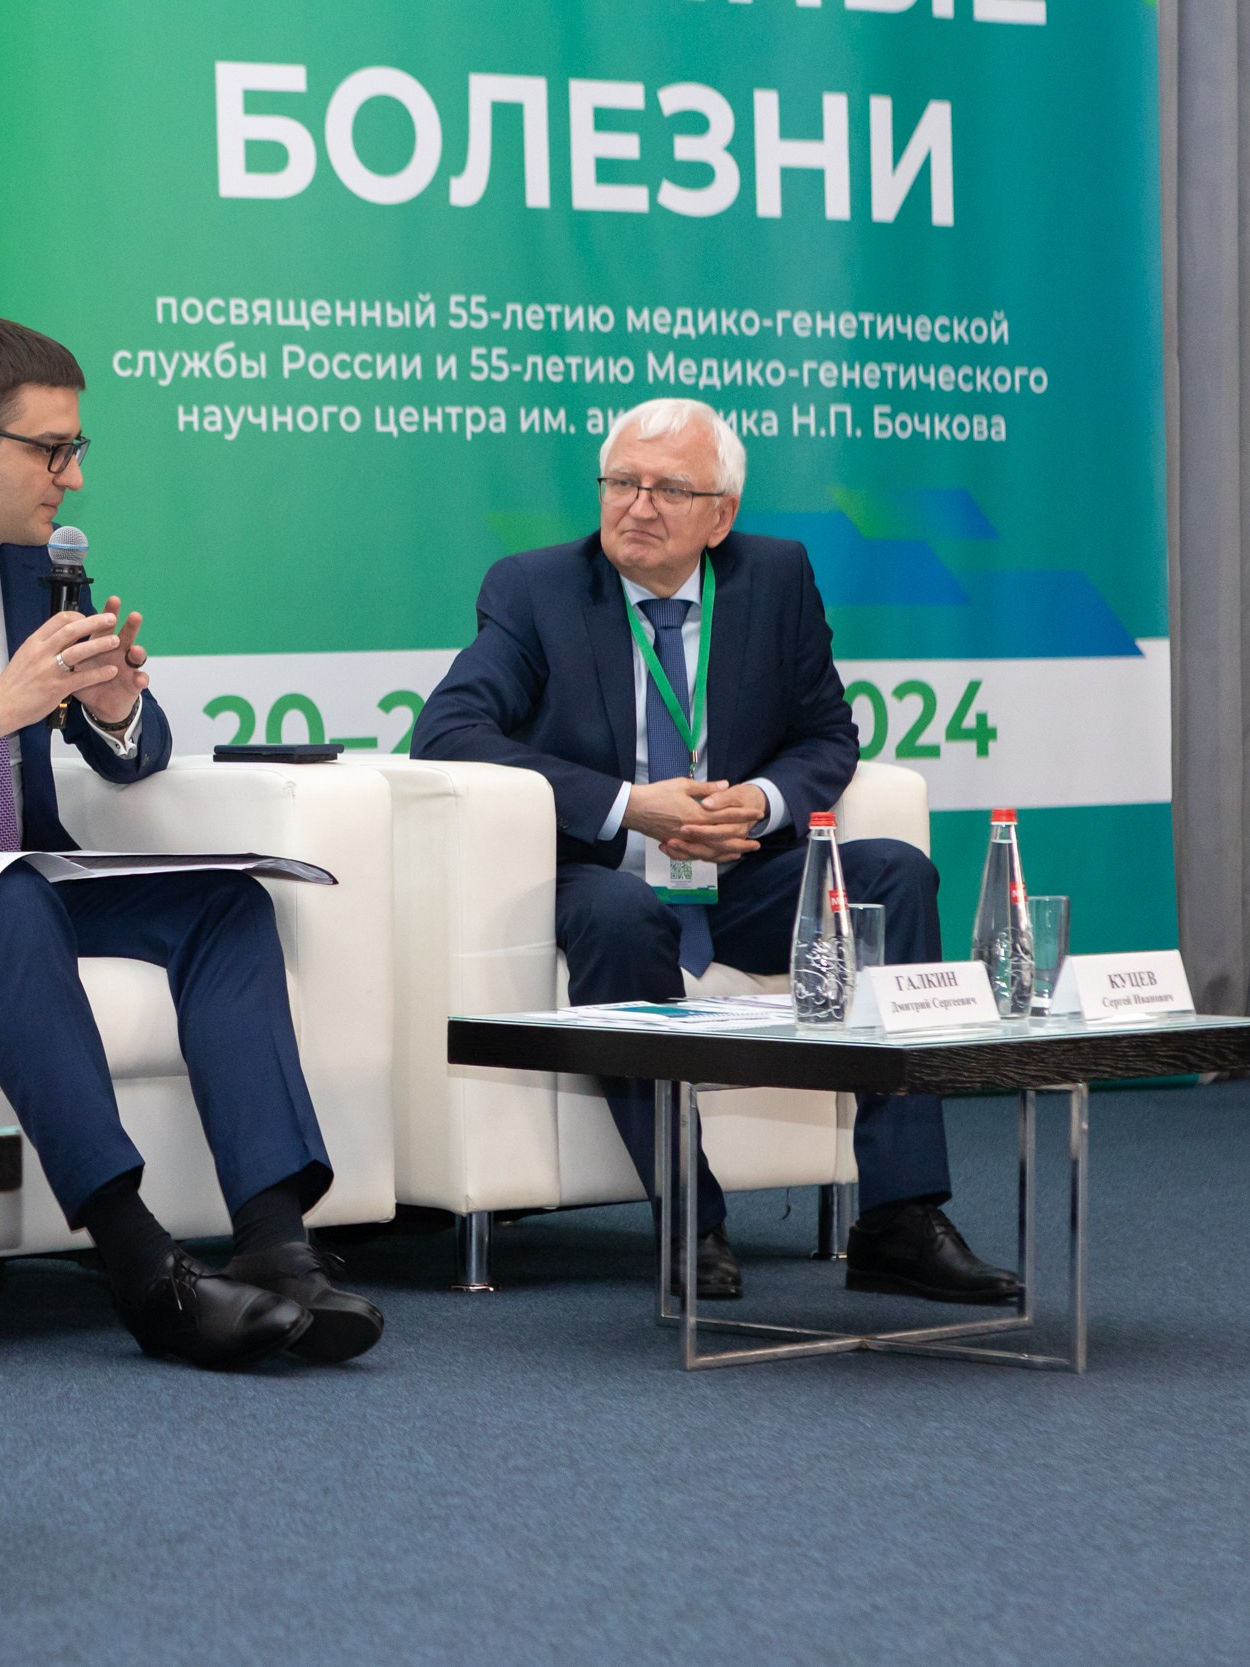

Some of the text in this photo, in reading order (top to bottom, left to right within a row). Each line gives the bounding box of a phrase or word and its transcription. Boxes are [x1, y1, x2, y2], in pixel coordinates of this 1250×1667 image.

[214, 60, 955, 227] БОЛЕЗНИ
[156, 294, 1008, 343] посвященный 55-летию медико-генетической
[112, 341, 1048, 393] службы России и 55-летию Медико-генетического
[177, 404, 1006, 441] научного центра им. акика Н.П. Бочкова
[843, 680, 997, 761] 024
[894, 971, 959, 992] ГАЛКИН
[1107, 970, 1158, 990] КУЦЕВ
[891, 998, 932, 1014] Дмитрий
